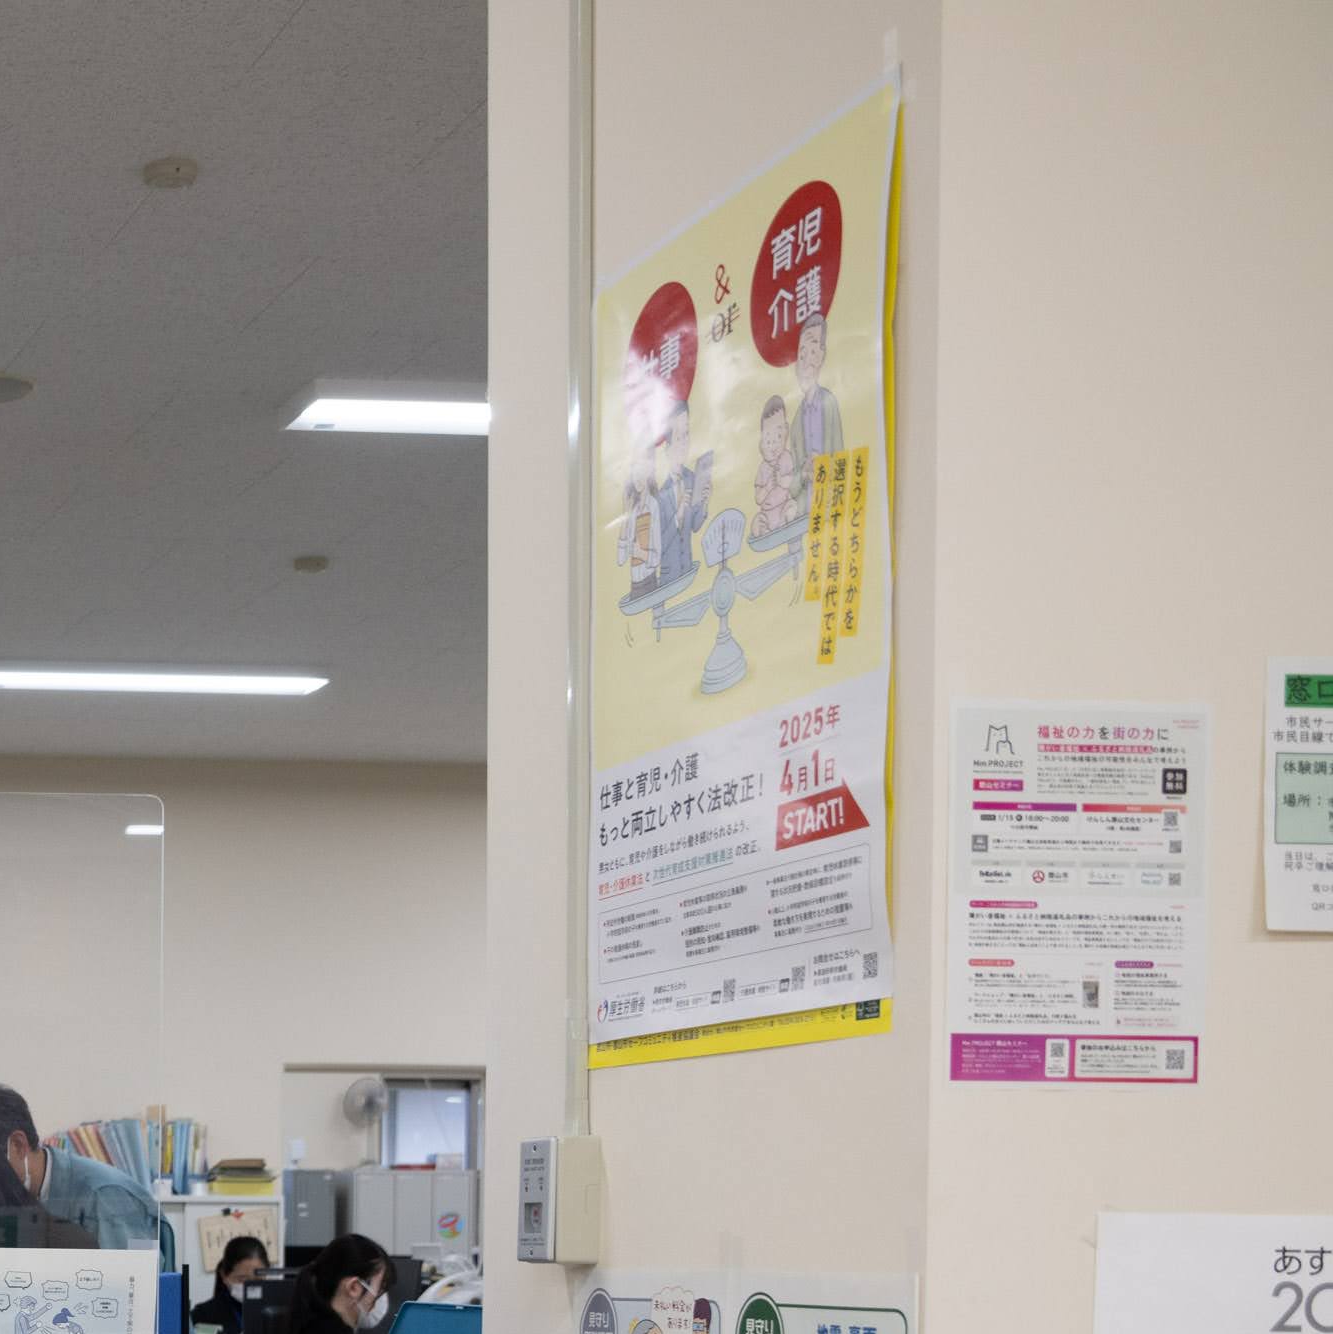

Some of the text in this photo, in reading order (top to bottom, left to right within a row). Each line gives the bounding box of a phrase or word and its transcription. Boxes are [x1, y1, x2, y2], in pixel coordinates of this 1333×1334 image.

[771, 206, 821, 279] 育児
[768, 265, 822, 339] 介護
[821, 458, 846, 657] 選択する時代では
[843, 455, 863, 631] もうどちらかを
[779, 705, 840, 748] 2025年
[1037, 725, 1169, 741] 福祉の力を街の力に
[600, 753, 699, 812] 仕事と育児・介護
[780, 750, 835, 796] 4月1日
[991, 760, 1024, 768] PROJECT
[1284, 761, 1333, 775] 体験調
[599, 774, 764, 847] もっと両立しやすく法改正！
[783, 797, 845, 839] START!
